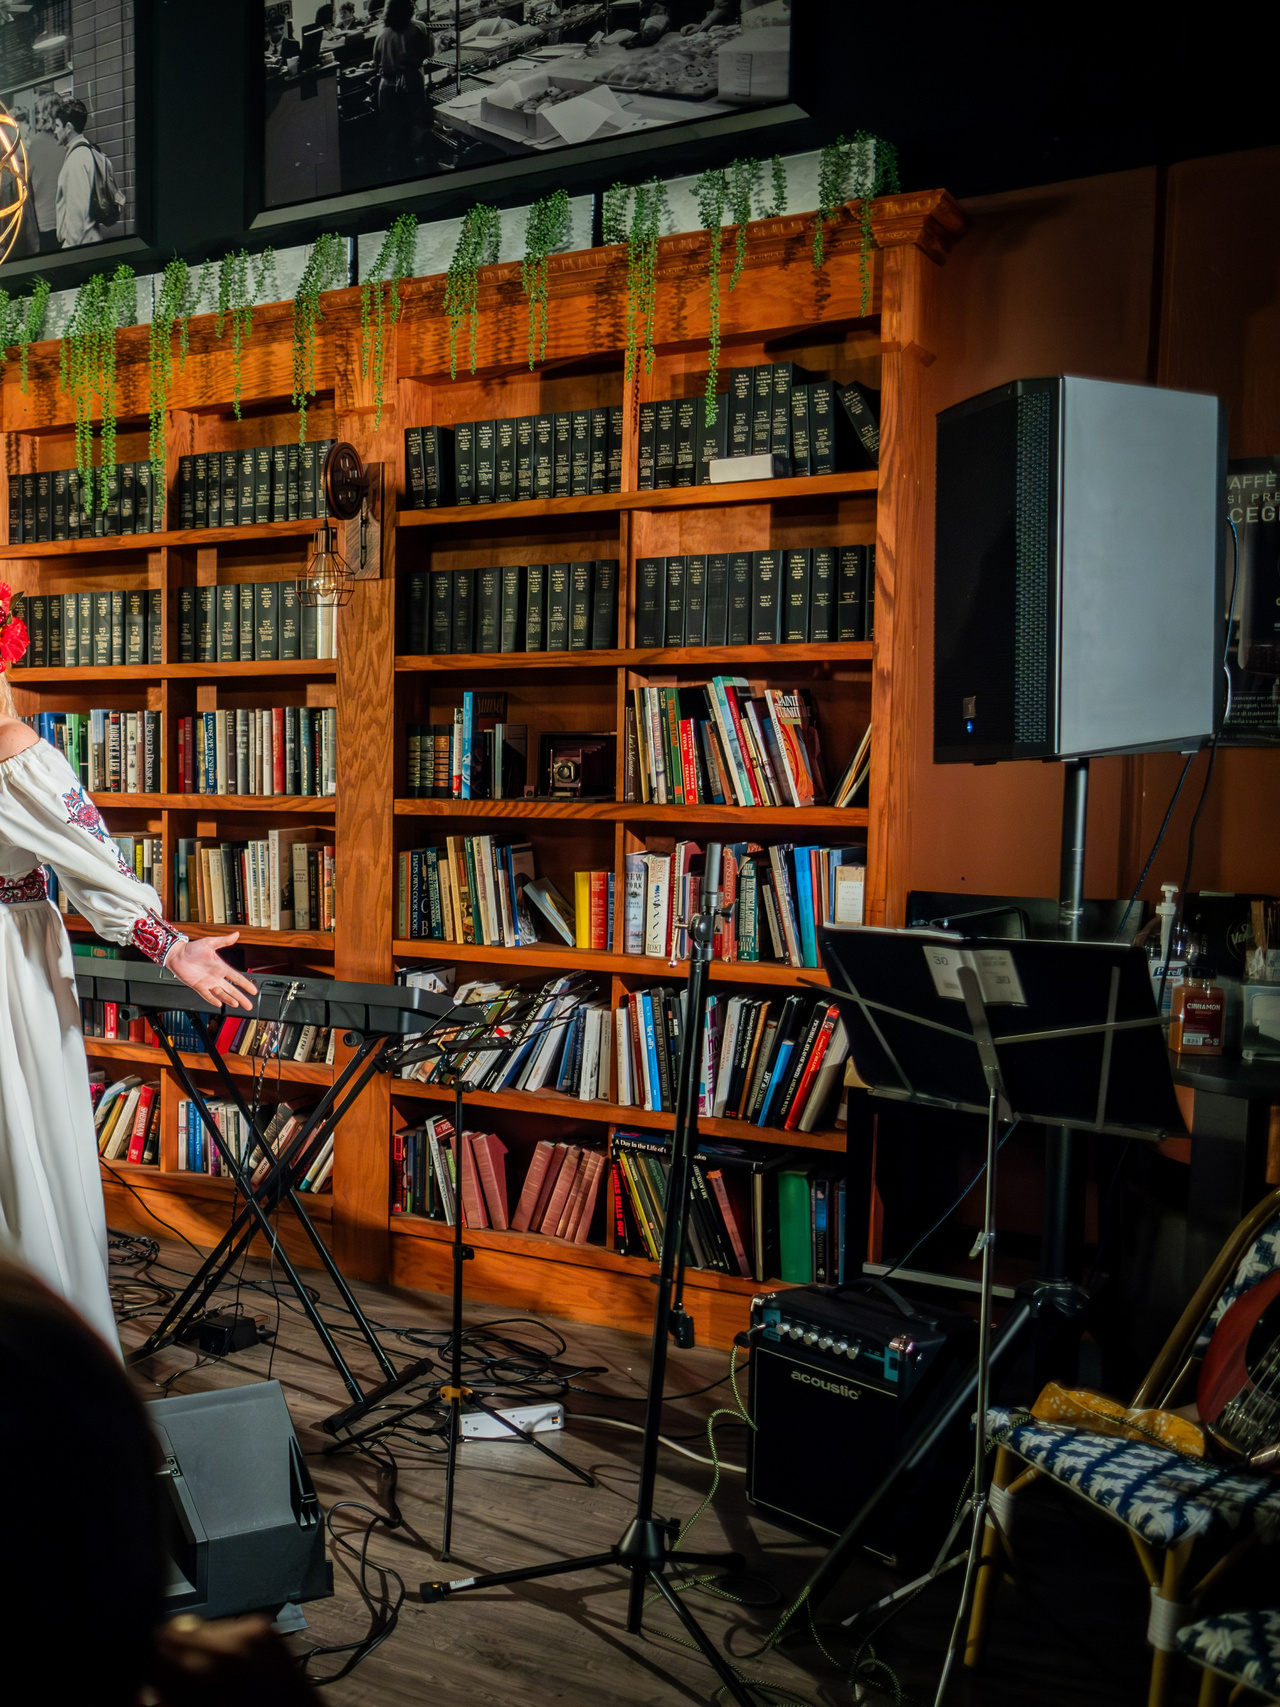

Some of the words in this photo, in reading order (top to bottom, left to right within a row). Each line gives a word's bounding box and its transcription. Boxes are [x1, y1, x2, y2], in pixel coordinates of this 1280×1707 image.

[1229, 505, 1280, 524] CEG
[110, 725, 120, 750] ROBERT
[110, 760, 120, 771] LEE
[933, 955, 948, 965] 30
[1156, 967, 1182, 976] Prell
[1186, 1002, 1221, 1011] CINNAMON
[136, 1106, 148, 1137] SHERMAN
[620, 1140, 631, 1148] Day
[614, 1195, 623, 1219] SELLS
[615, 1221, 625, 1237] OUT
[790, 1370, 860, 1400] acoustic
